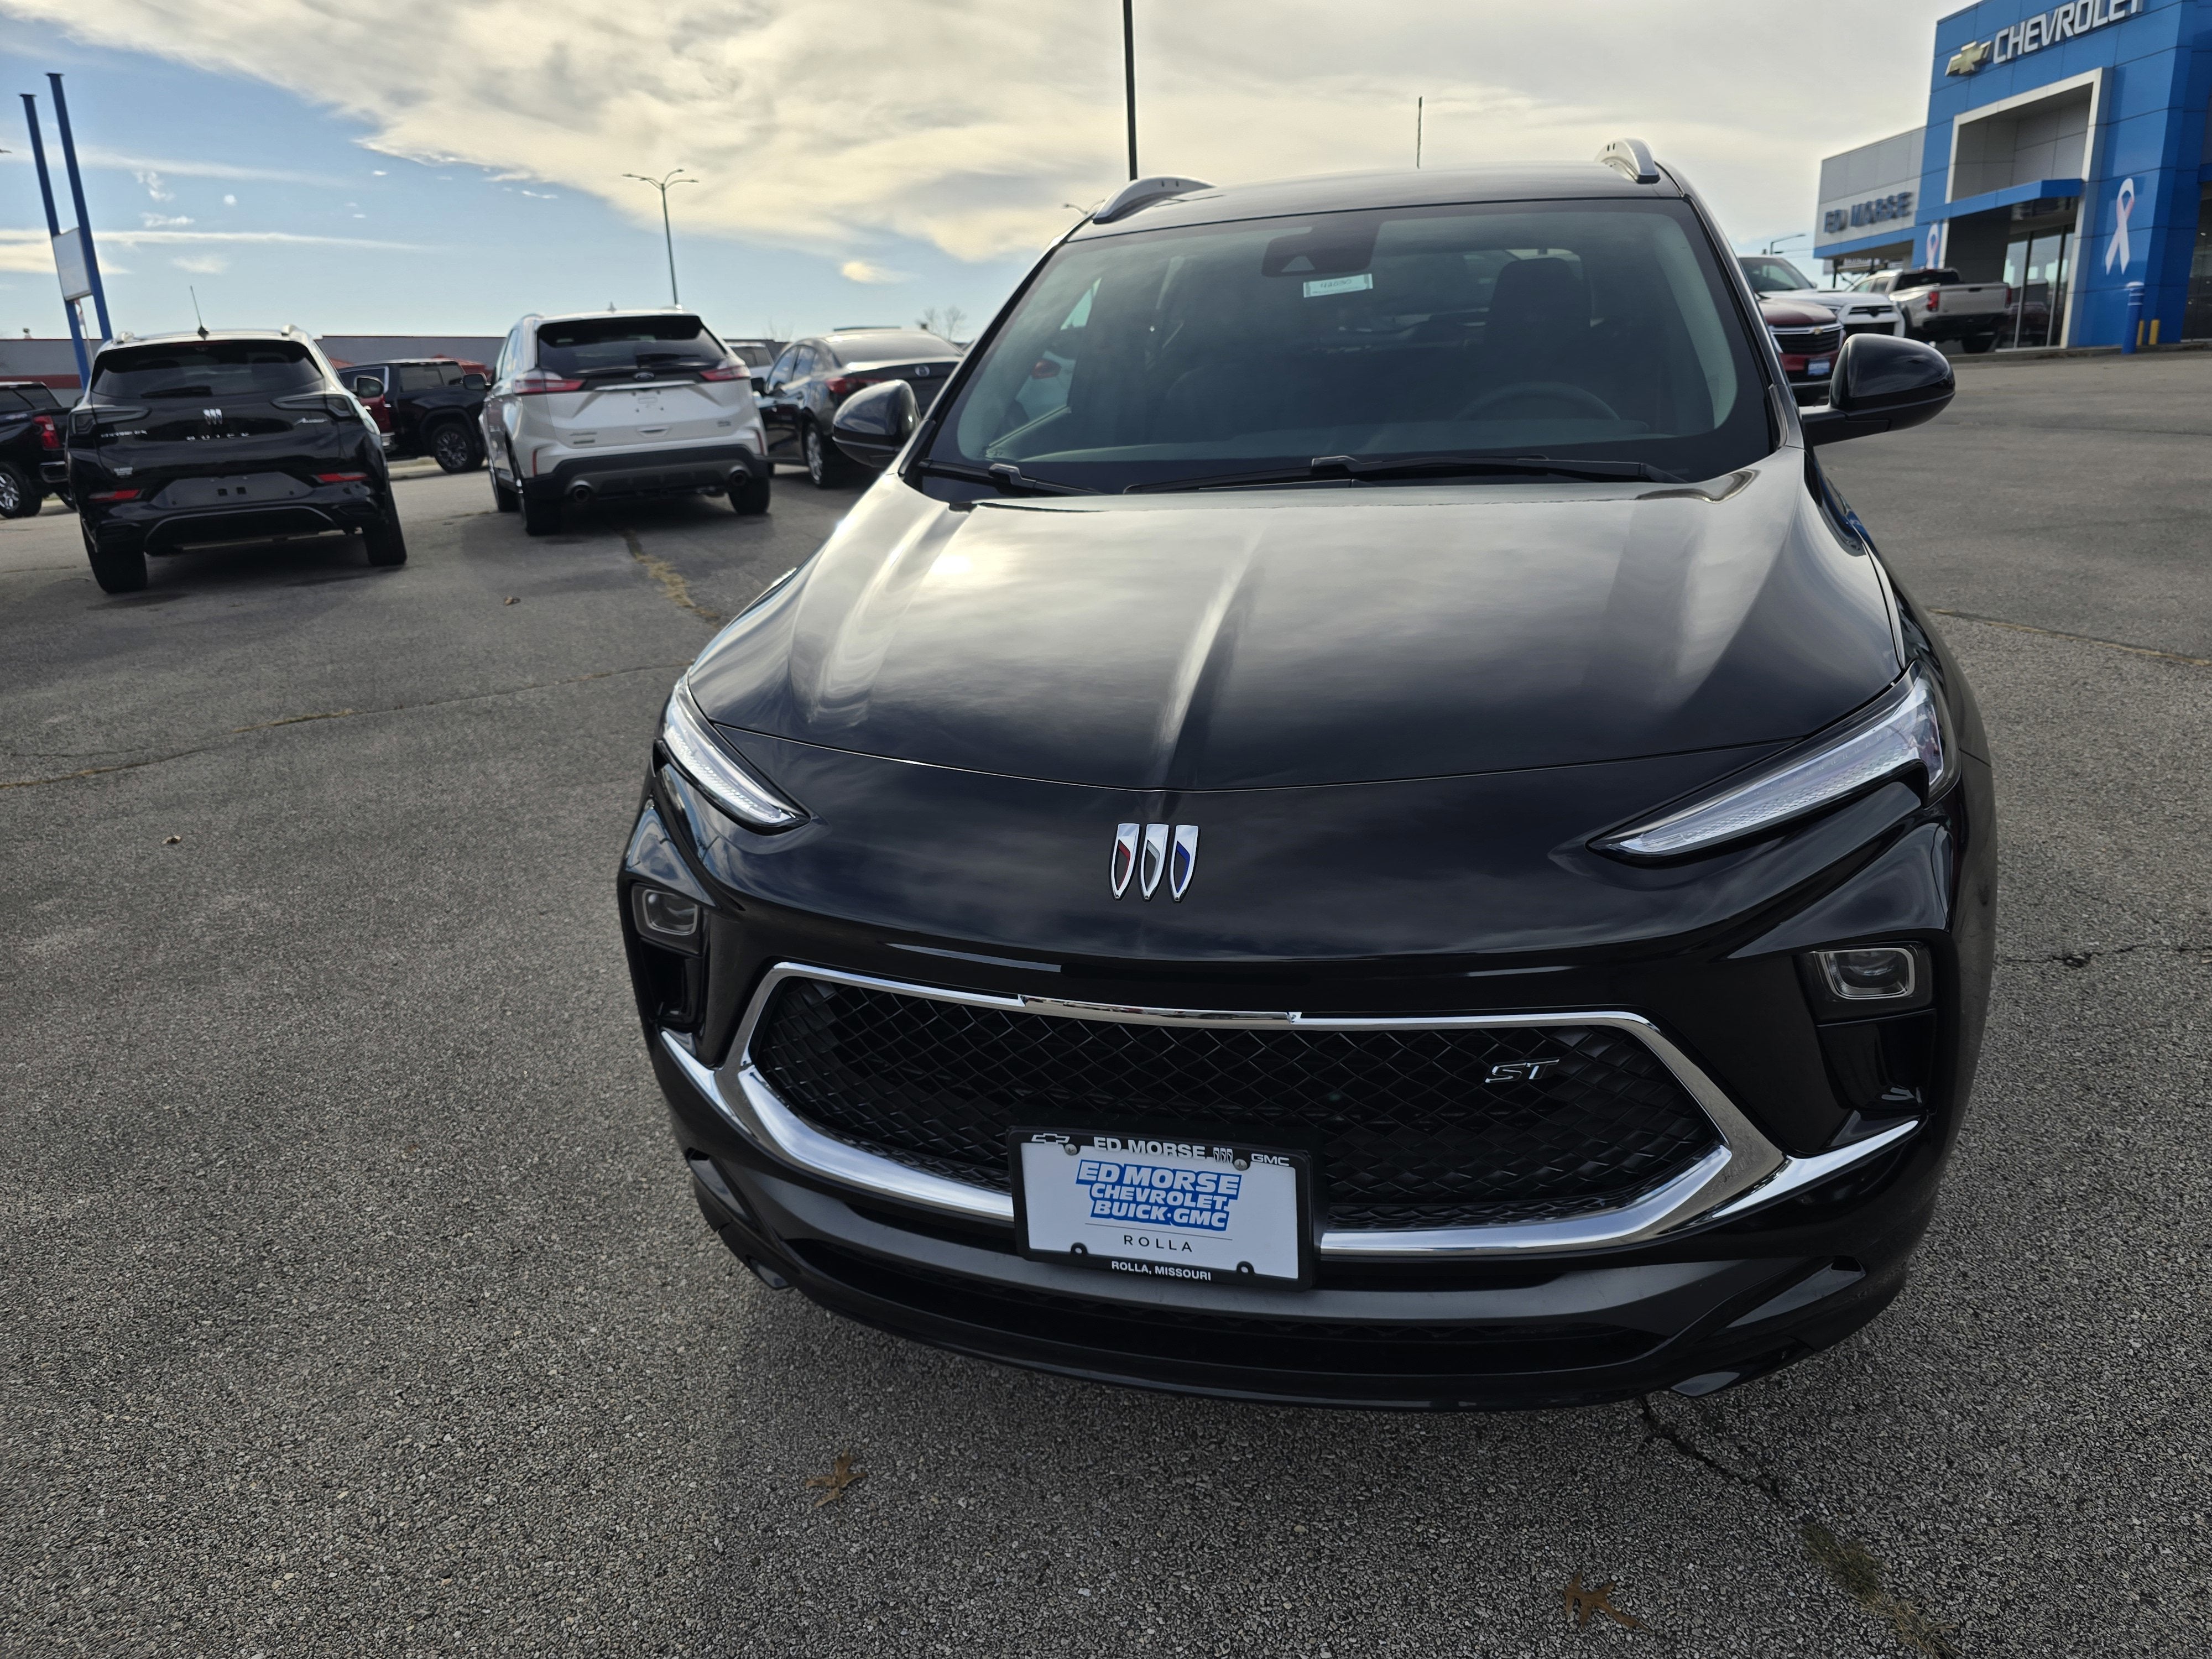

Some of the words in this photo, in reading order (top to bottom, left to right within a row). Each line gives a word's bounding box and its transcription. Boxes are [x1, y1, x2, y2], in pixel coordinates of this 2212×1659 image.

[1484, 1057, 1561, 1083] ST
[1093, 1136, 1121, 1152] ED
[1128, 1139, 1206, 1160] MORSE
[1251, 1153, 1290, 1166] GMC
[1078, 1161, 1120, 1183] ED
[1123, 1165, 1240, 1195] MORSE
[1091, 1182, 1227, 1210] CHEVROLET
[1124, 1235, 1193, 1253] ROLLA
[1112, 1260, 1152, 1275] ROLLA,
[1155, 1266, 1212, 1281] MISSOURI
